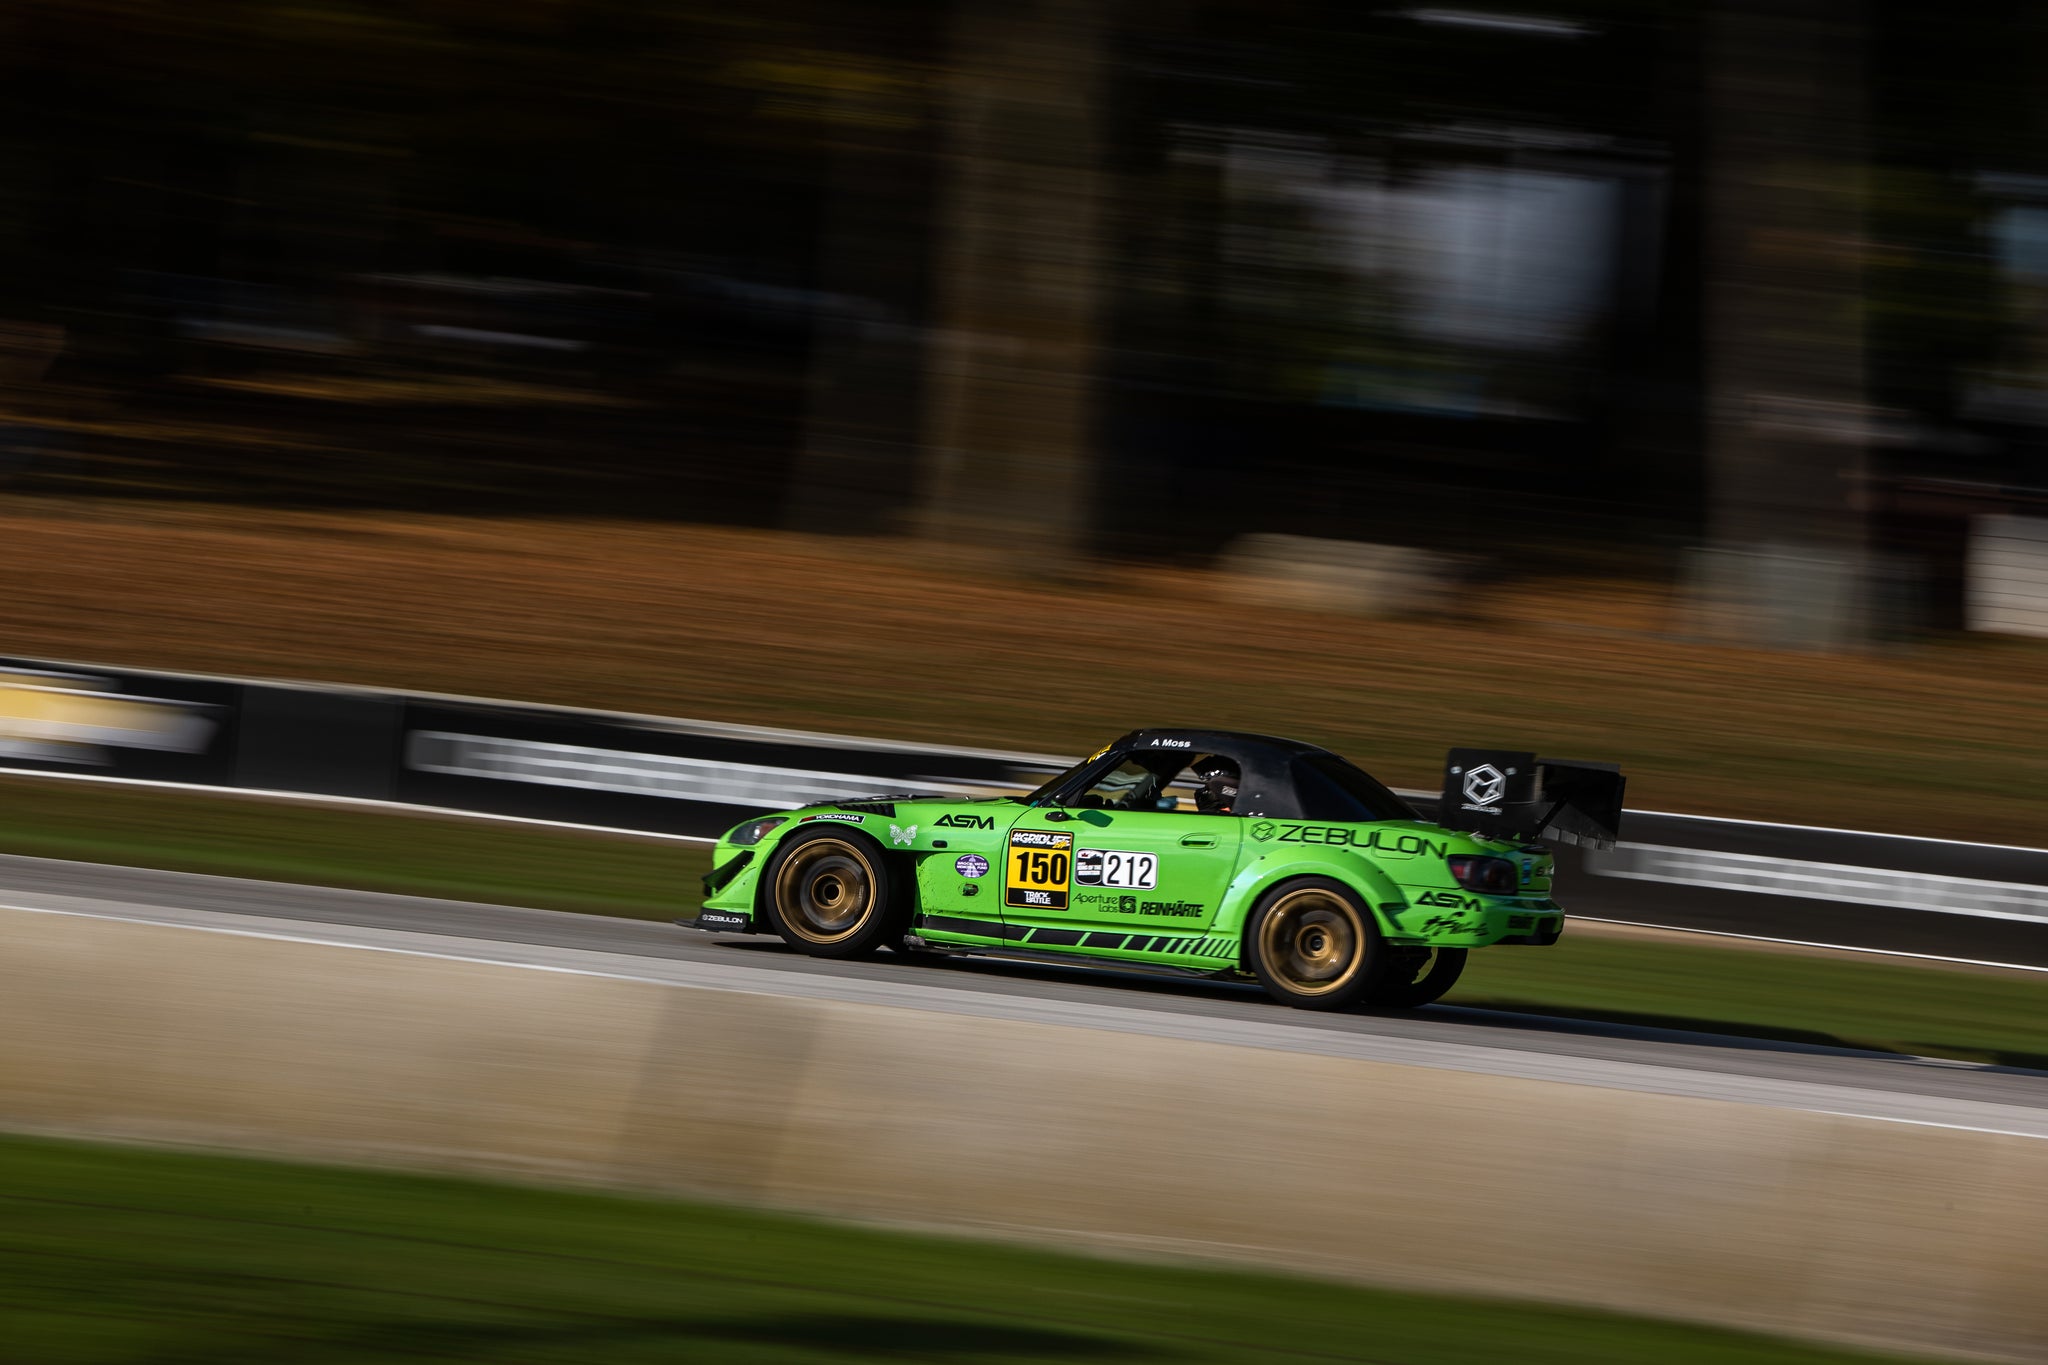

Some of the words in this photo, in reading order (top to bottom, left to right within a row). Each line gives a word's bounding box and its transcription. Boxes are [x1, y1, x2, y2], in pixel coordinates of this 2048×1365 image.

[1150, 738, 1159, 747] A
[1161, 738, 1191, 748] Moss
[815, 813, 861, 822] YOKOHAMA
[933, 813, 995, 831] ASM
[1277, 824, 1448, 860] ZEBULON
[1016, 851, 1068, 885] 150
[1106, 854, 1152, 887] 212
[1024, 890, 1050, 899] TRACK
[1072, 892, 1119, 905] Aperture
[1025, 896, 1052, 905] BATTLE
[1413, 890, 1483, 913] ASM
[1098, 903, 1119, 913] Labs
[708, 914, 743, 924] ZEBULON
